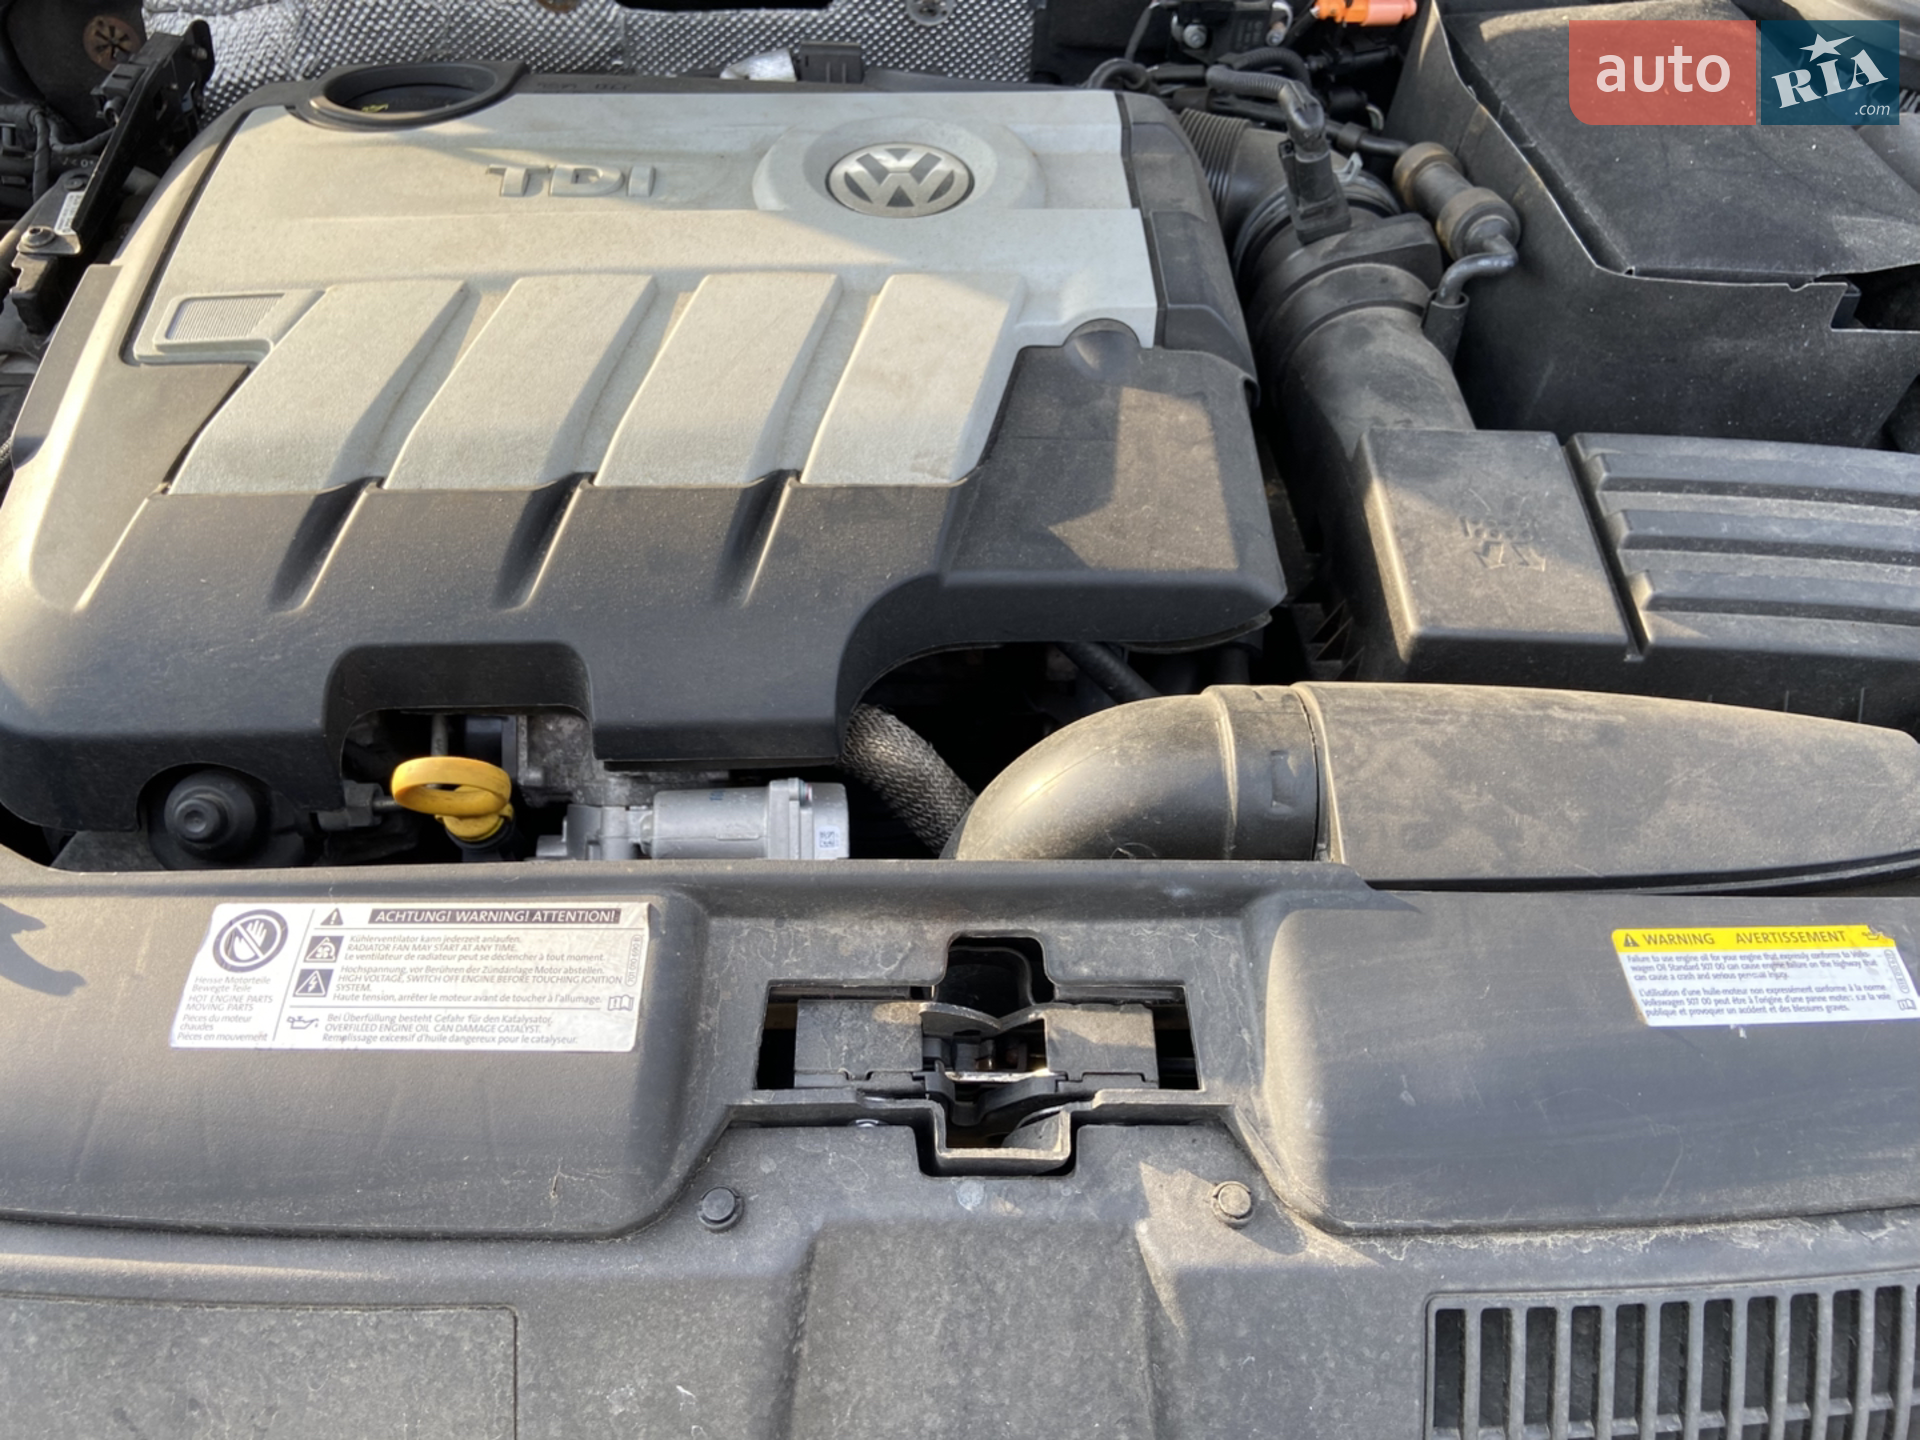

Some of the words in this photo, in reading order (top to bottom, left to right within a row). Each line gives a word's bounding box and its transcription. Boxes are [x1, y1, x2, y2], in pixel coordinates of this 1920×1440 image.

[485, 164, 656, 197] TDI
[375, 911, 452, 922] ACHTUNG!
[456, 910, 529, 922] WARNING!
[532, 911, 616, 922] ATTENTION!
[1643, 933, 1715, 945] WARNING
[1736, 931, 1846, 944] AVERTISSEMENT
[532, 976, 579, 984] TOUCHING
[581, 976, 623, 984] IGNITION
[379, 1024, 416, 1032] ENGINE
[434, 1024, 453, 1032] CAN
[455, 1024, 499, 1032] DAMAGE
